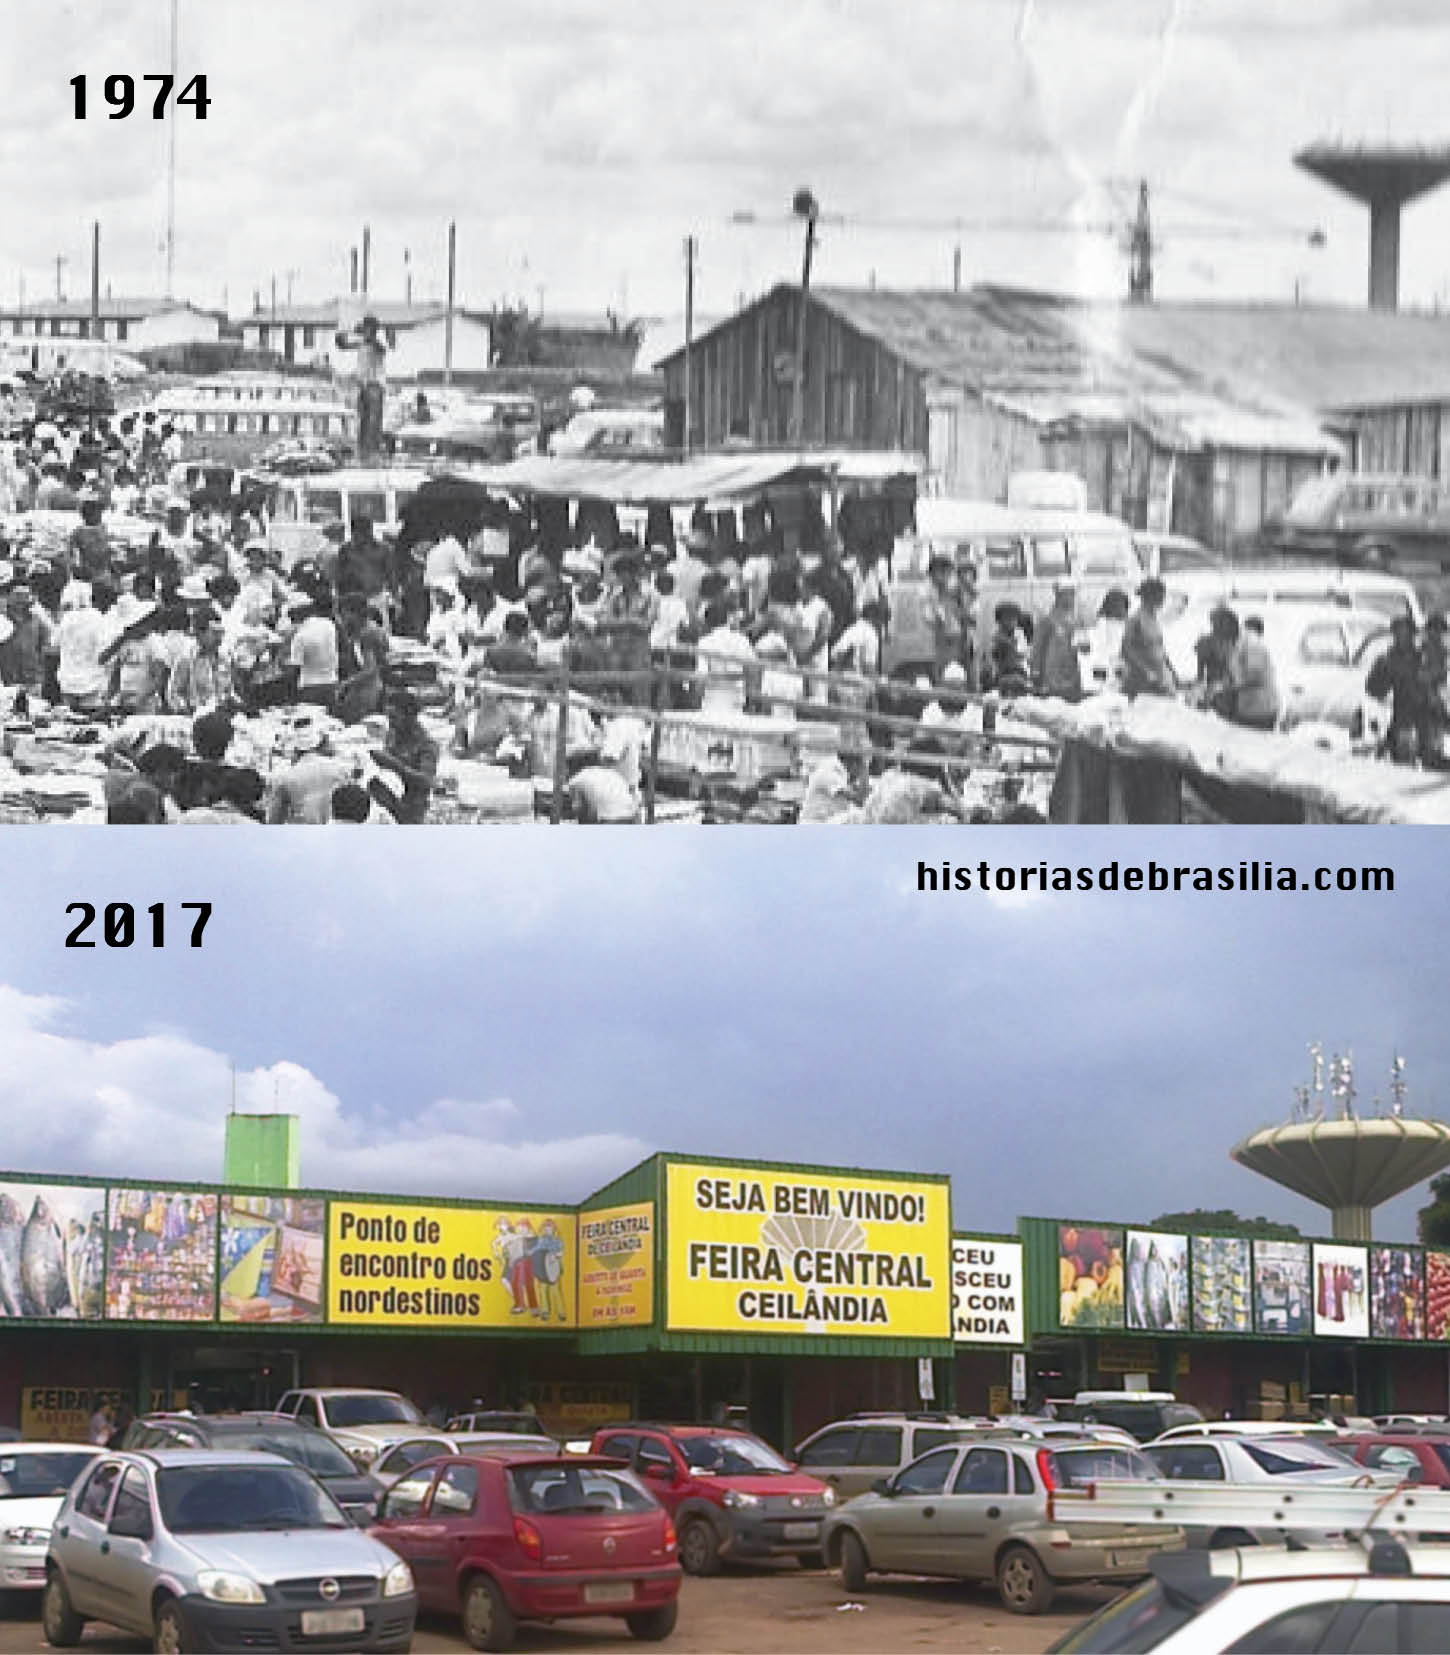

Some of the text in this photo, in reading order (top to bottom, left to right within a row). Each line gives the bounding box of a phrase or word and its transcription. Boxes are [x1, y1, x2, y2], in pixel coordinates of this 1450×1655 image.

[696, 1179, 925, 1222] SEJA BEM VINDO!
[340, 1212, 440, 1244] Ponto de
[340, 1252, 492, 1281] encontro dos
[689, 1243, 784, 1282] FEIRA
[793, 1250, 932, 1288] CENTRAL
[339, 1286, 481, 1316] nordestinos
[738, 1288, 888, 1323] CEILÂNDIA
[968, 1294, 1015, 1312] COM
